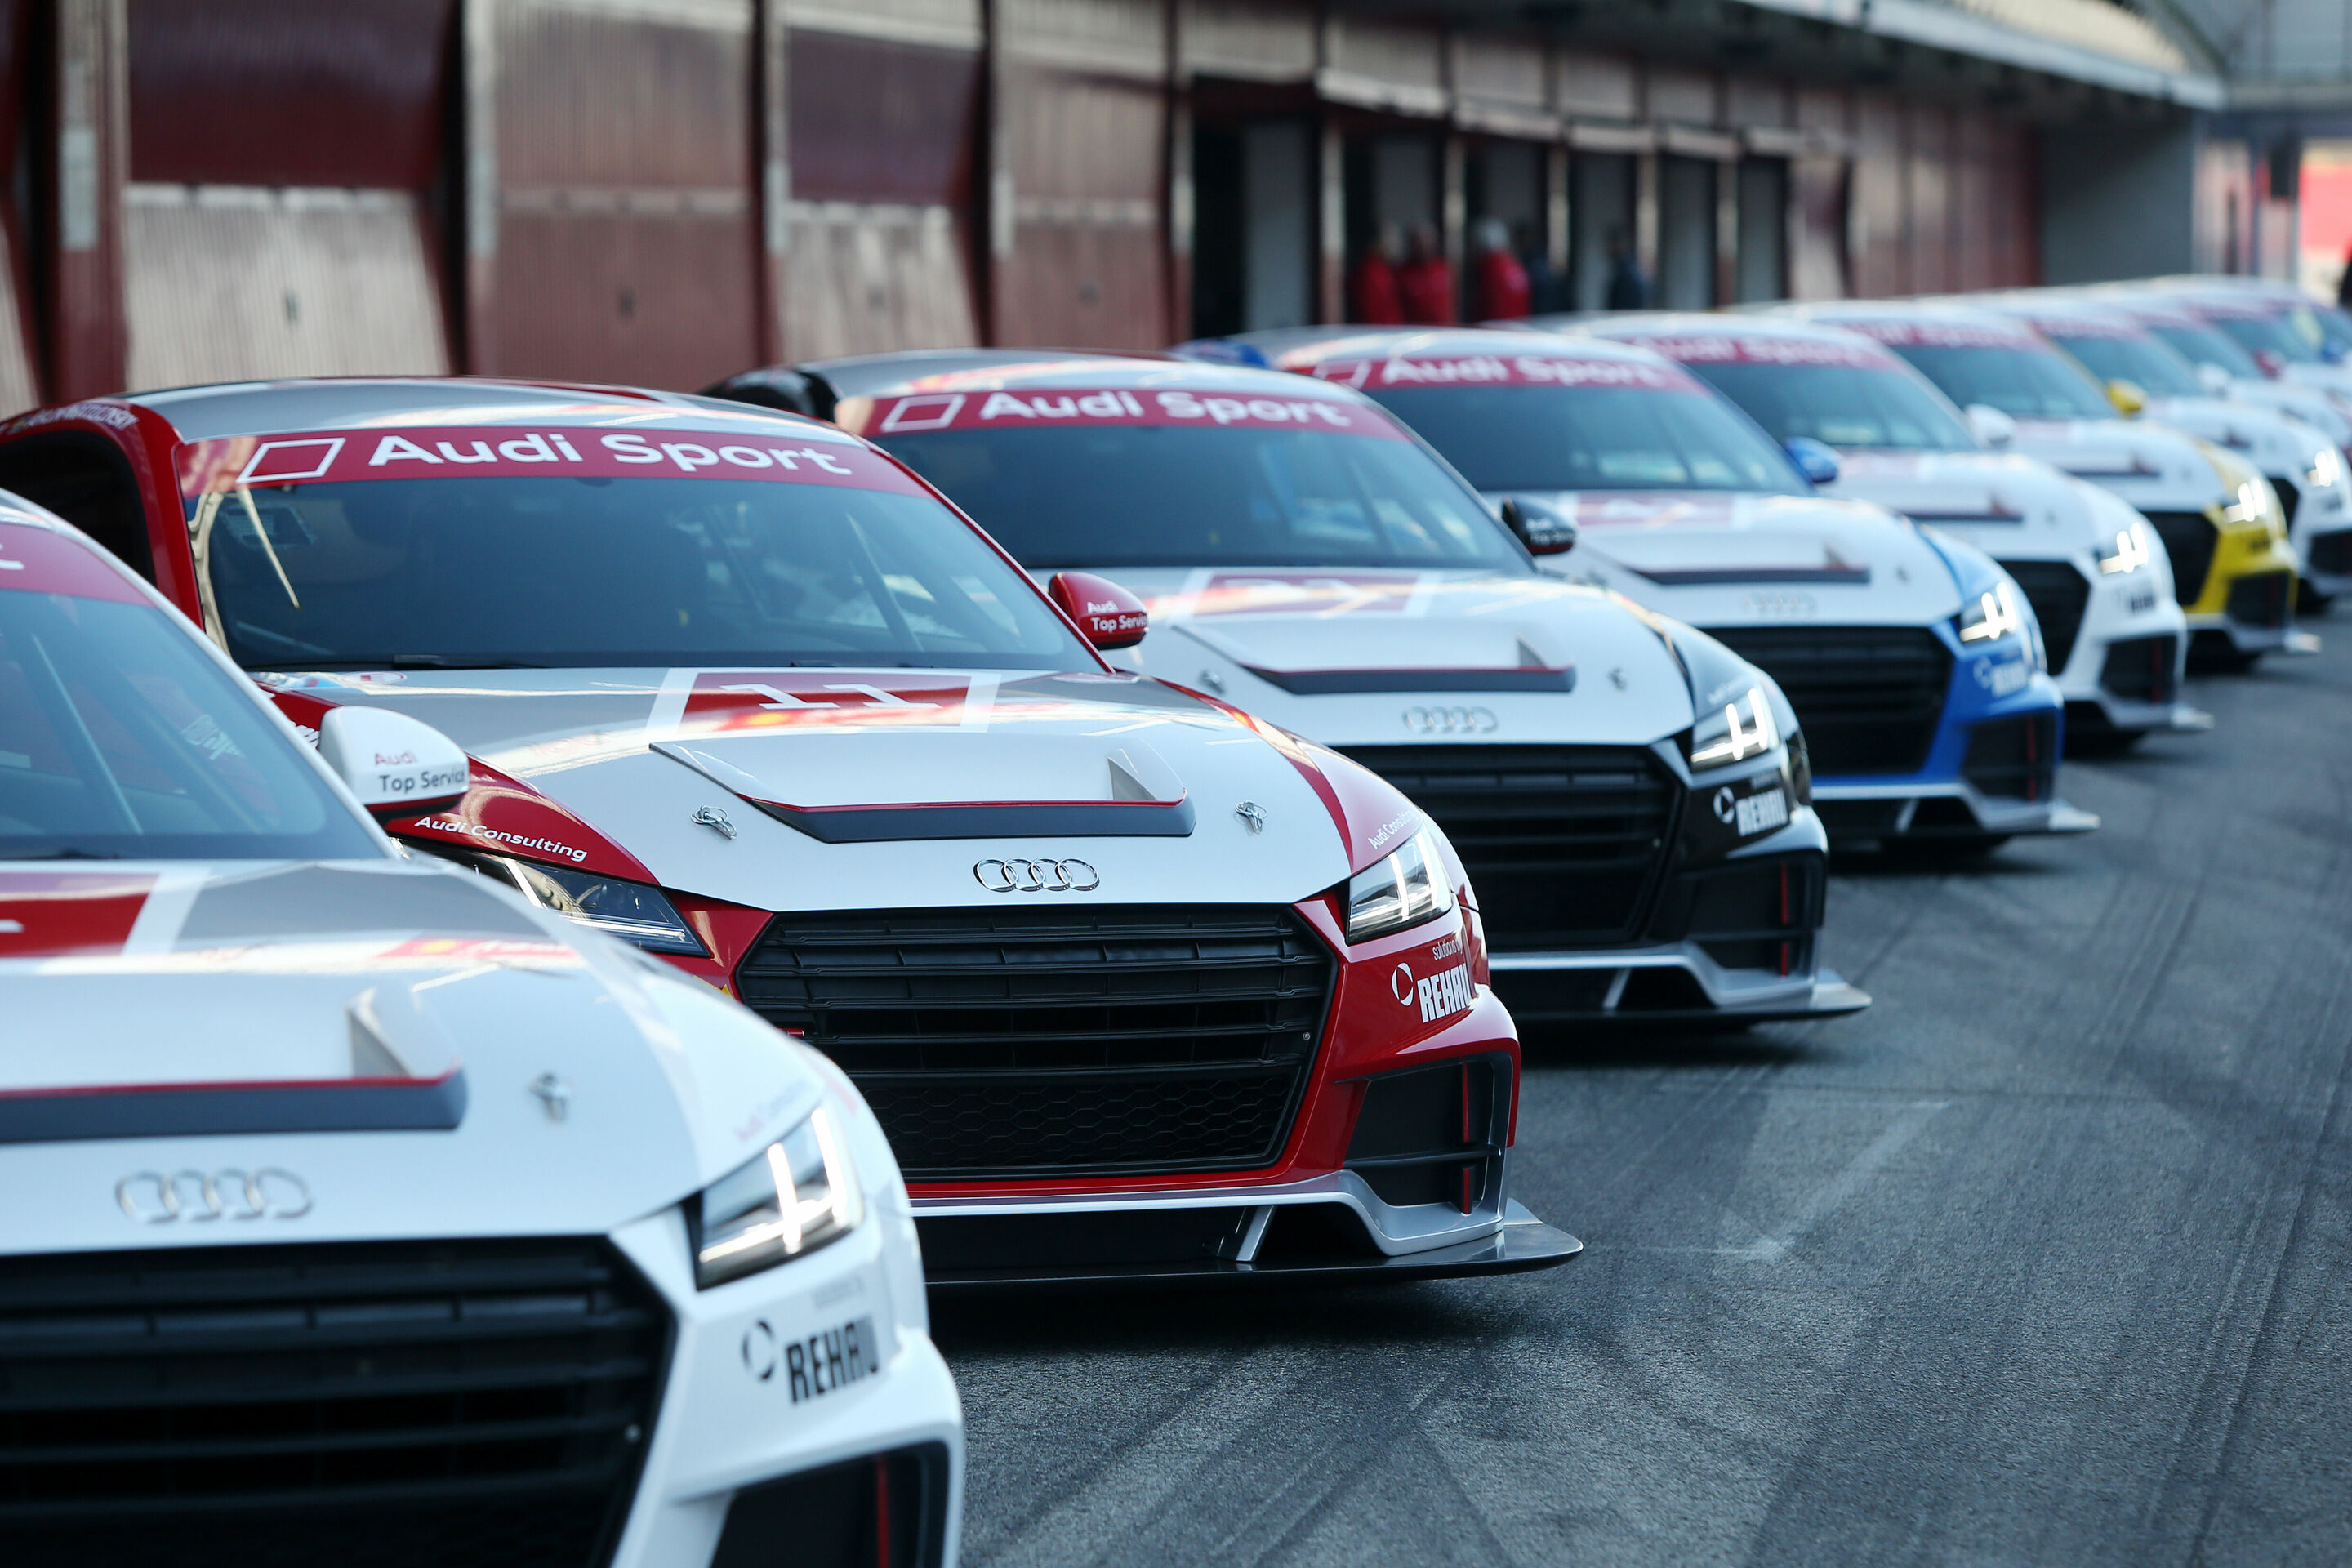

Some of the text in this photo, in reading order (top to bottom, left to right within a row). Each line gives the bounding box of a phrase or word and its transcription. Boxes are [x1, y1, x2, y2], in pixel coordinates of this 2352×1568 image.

[1381, 354, 1663, 387] Audi Sport
[979, 390, 1352, 427] Audi Sport
[368, 433, 853, 475] Audi Sport
[1087, 600, 1119, 613] Audi
[1090, 617, 1117, 634] Top
[719, 683, 943, 710] 11
[375, 751, 418, 765] Audi
[378, 774, 415, 793] Top
[414, 817, 588, 862] Audi Consulting
[1368, 828, 1390, 849] Audi
[1432, 939, 1457, 960] solutions
[1417, 963, 1471, 1023] REHAU
[786, 1312, 880, 1405] REHAU
